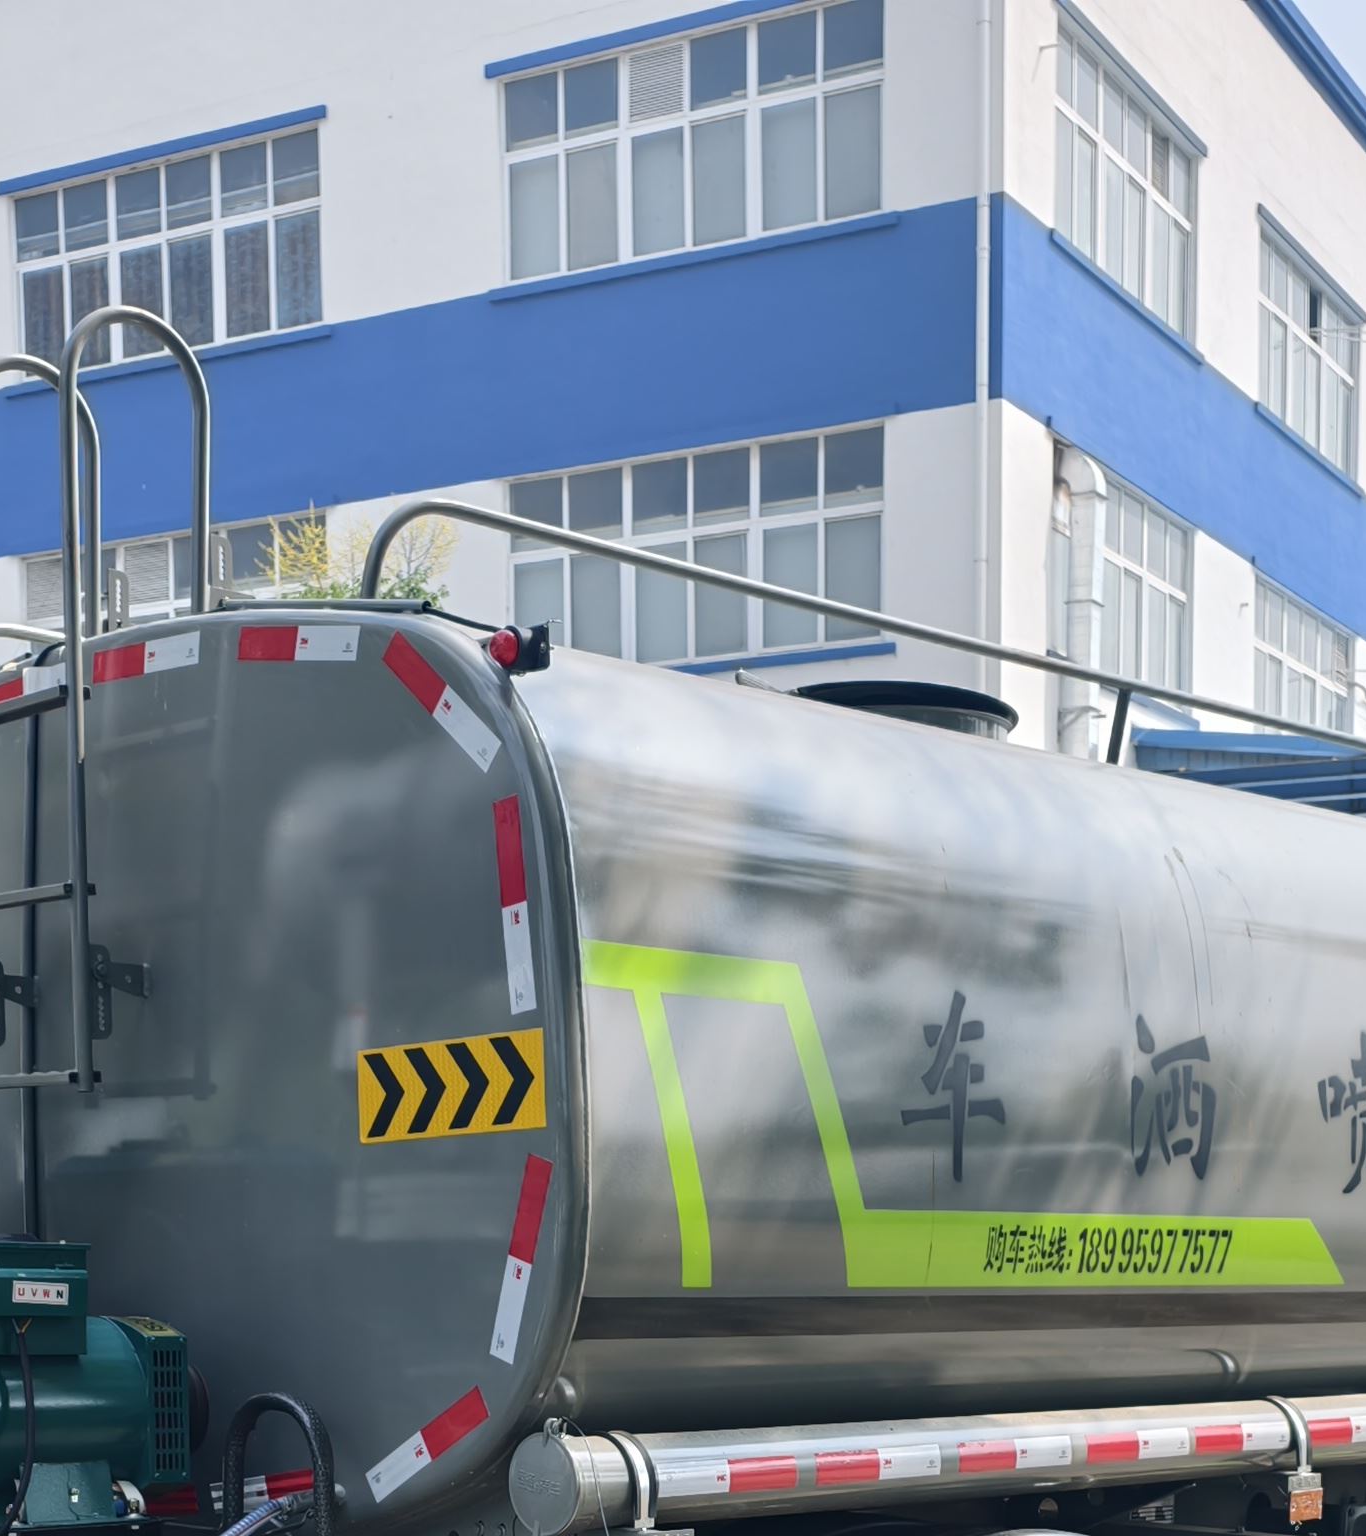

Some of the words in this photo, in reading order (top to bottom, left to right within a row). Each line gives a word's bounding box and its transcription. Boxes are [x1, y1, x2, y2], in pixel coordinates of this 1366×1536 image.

[18, 1287, 25, 1297] U
[31, 1288, 38, 1297] V
[42, 1288, 50, 1299] W
[56, 1289, 64, 1299] N
